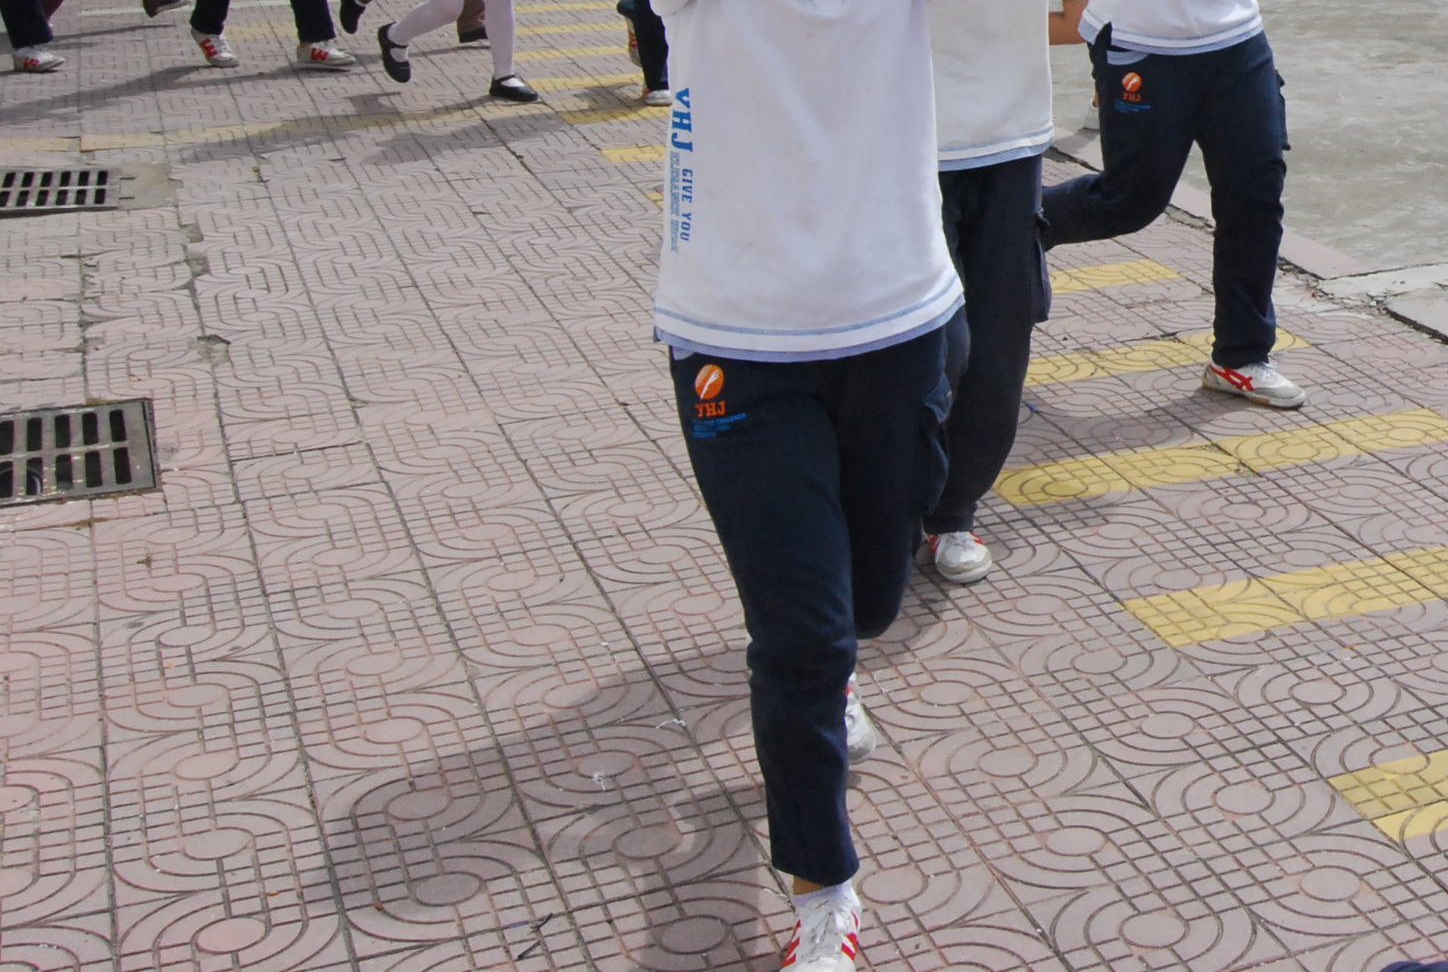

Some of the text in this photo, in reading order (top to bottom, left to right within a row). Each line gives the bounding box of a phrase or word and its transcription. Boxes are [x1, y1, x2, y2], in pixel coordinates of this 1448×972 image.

[680, 169, 693, 242] GIVE YOU
[695, 401, 727, 417] YHJ
